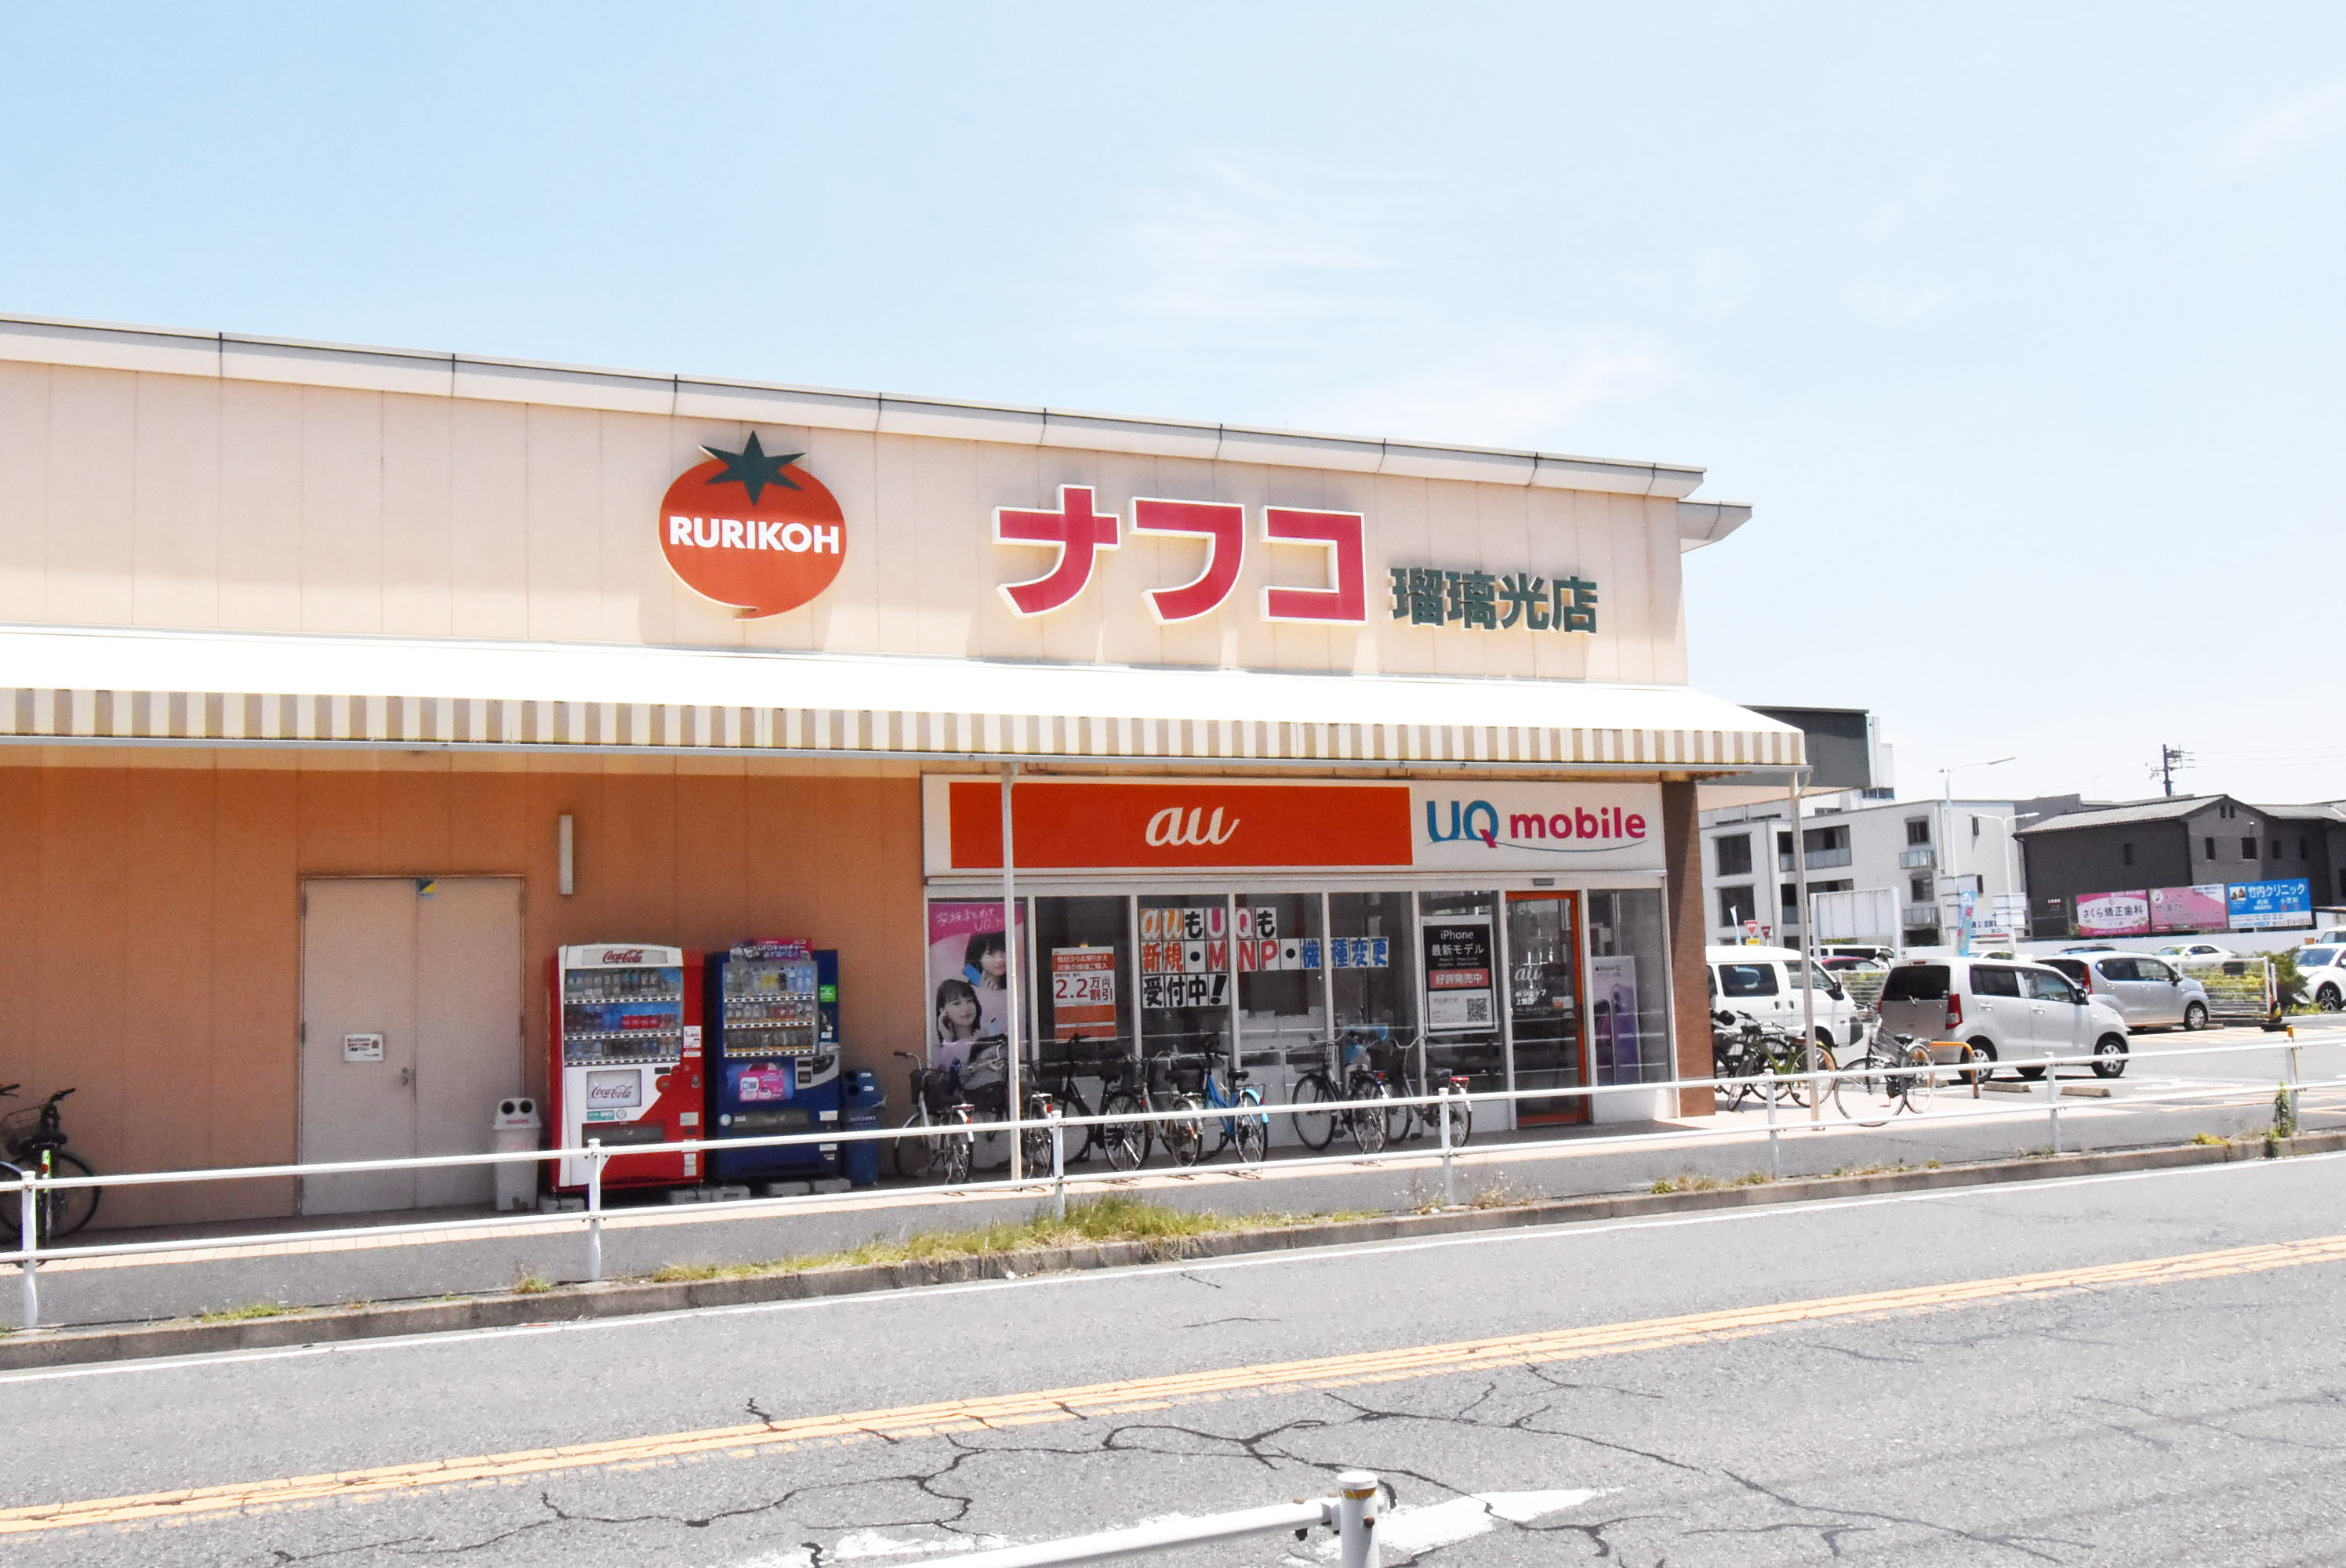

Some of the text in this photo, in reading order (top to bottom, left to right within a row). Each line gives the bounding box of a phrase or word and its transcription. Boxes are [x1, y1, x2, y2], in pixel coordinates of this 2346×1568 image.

[669, 515, 840, 555] RURIKOH
[991, 483, 1368, 625] ナフコ
[1386, 567, 1599, 633] 瑠璃光店
[1144, 806, 1240, 846] au
[1426, 800, 1646, 848] UQ mobile
[2247, 883, 2305, 898] 竹内クリニック
[2083, 905, 2144, 919] さくら矯正歯科
[1432, 943, 1484, 956] 最新モデル
[1440, 929, 1474, 940] iPhone
